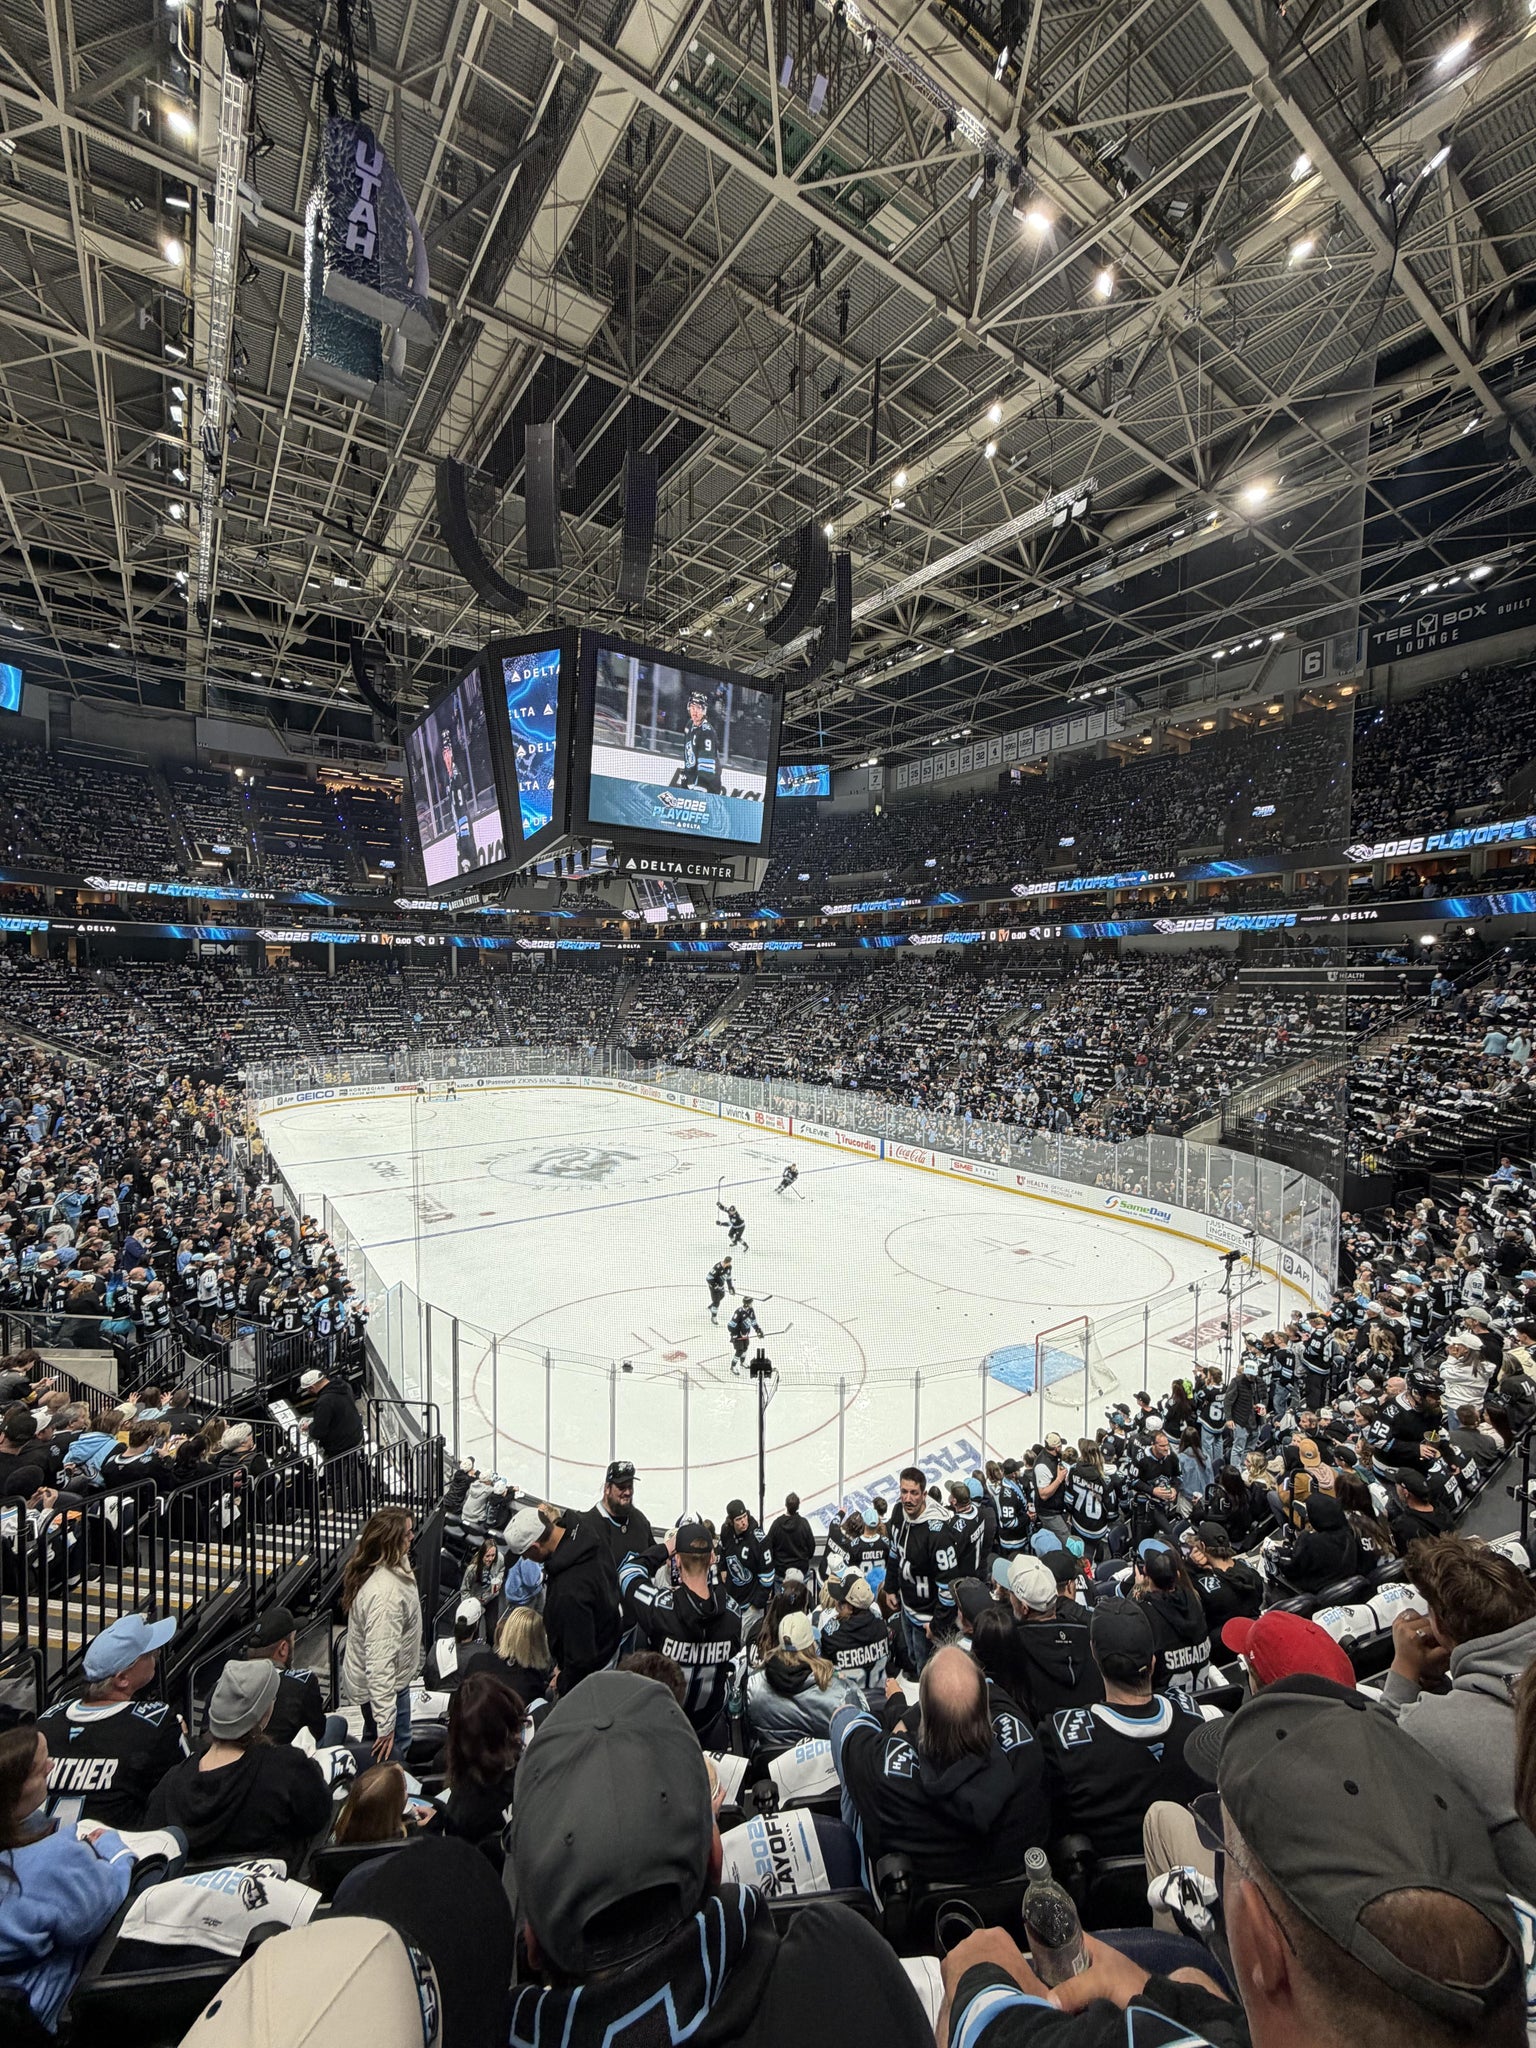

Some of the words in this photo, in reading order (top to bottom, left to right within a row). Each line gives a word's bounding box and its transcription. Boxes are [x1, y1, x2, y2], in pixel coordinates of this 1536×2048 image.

[345, 139, 384, 260] UTAH
[1497, 597, 1532, 616] BUILT
[1372, 624, 1413, 645] TEE
[1442, 602, 1488, 626] BOX
[1395, 628, 1460, 656] LOUNGE
[1304, 650, 1321, 675] 6
[975, 751, 985, 761] 32
[652, 805, 710, 825] PLAYOFFS
[674, 797, 706, 813] 2026
[1371, 836, 1426, 859] 2026
[1424, 819, 1529, 852] PLAYOFFS
[639, 858, 684, 874] DELTA
[686, 863, 733, 880] CENTER
[108, 879, 147, 893] 2026
[147, 883, 216, 899] PLAYOFFS
[249, 892, 275, 900] DELTA
[1026, 880, 1057, 895] 2026
[1056, 873, 1118, 893] PLAYOFFS
[1147, 871, 1176, 881] DELTA
[86, 925, 117, 933] DELTA
[1173, 917, 1216, 932] 2026
[1214, 912, 1298, 931] PLAYOFFS
[1342, 909, 1379, 921] DELTA
[276, 931, 311, 942] 2026
[531, 940, 556, 949] 2026
[556, 939, 601, 950] PLAYOFFS
[296, 1090, 335, 1102] GEICO
[841, 1134, 876, 1152] Trucordia
[953, 1161, 974, 1172] SME
[1026, 1179, 1049, 1188] HEALTH
[1119, 1200, 1173, 1221] SameDay
[1209, 1220, 1226, 1230] JUST
[1370, 1420, 1390, 1438] 92
[1002, 1505, 1015, 1519] 92
[1073, 1484, 1103, 1521] 70
[741, 1546, 749, 1560] C
[763, 1549, 772, 1565] 9
[861, 1550, 885, 1560] COOLEY
[935, 1545, 959, 1571] 92
[633, 1583, 660, 1606] 11
[661, 1637, 732, 1665] GUENTHER
[1000, 1715, 1014, 1748] UTAH
[1068, 1710, 1087, 1741] UTAH
